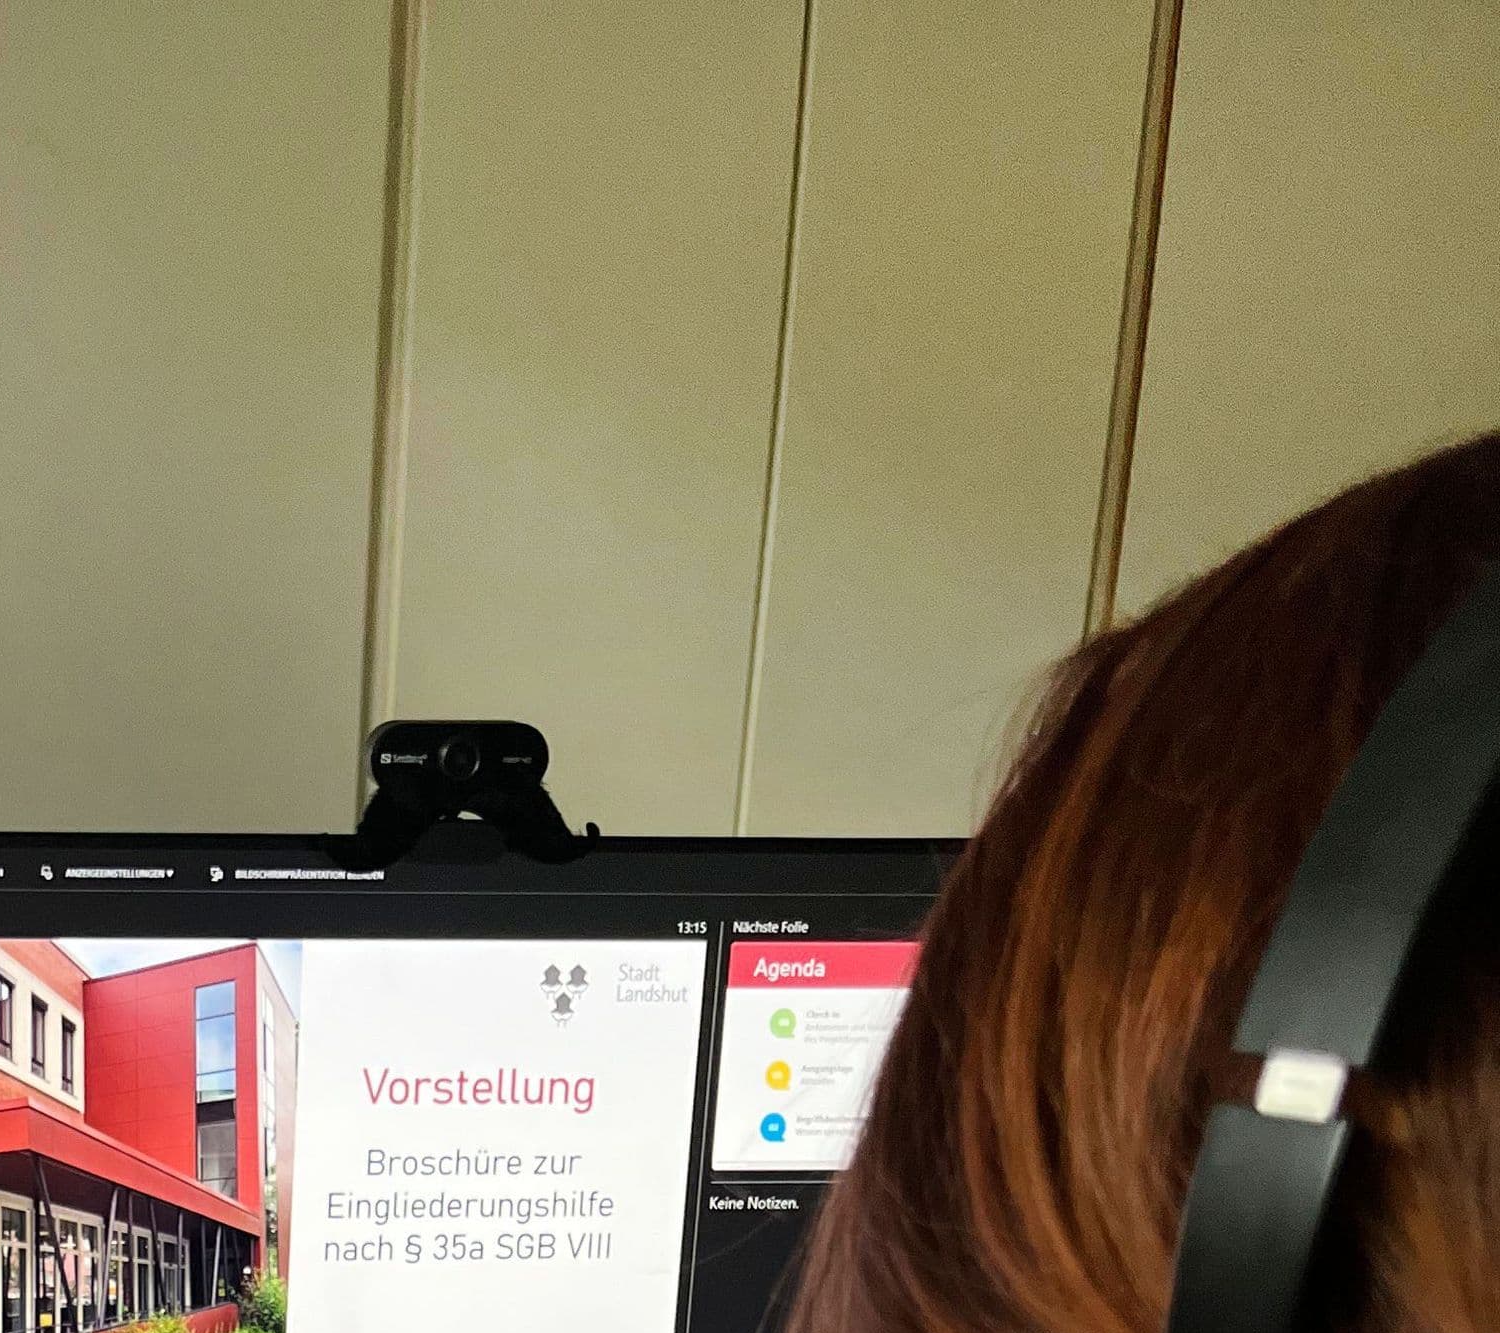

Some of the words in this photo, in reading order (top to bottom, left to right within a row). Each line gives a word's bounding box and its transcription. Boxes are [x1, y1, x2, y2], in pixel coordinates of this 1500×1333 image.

[676, 920, 707, 934] 13:15
[732, 920, 778, 934] Nächste
[780, 920, 809, 934] Folie
[618, 963, 661, 982] Stadt
[753, 958, 826, 982] Agenda
[616, 984, 688, 1003] Landshut
[363, 1068, 595, 1113] Vorstellung
[366, 1149, 522, 1177] Broschüre
[533, 1153, 582, 1176] zur
[327, 1192, 615, 1226] Eingliederungshilfe
[709, 1196, 745, 1211] Keine
[747, 1195, 800, 1211] Notizen.
[324, 1235, 393, 1263] nach
[405, 1235, 422, 1265] §
[432, 1235, 485, 1262] 35a
[495, 1234, 556, 1260] SGB
[567, 1233, 612, 1260] VIII
